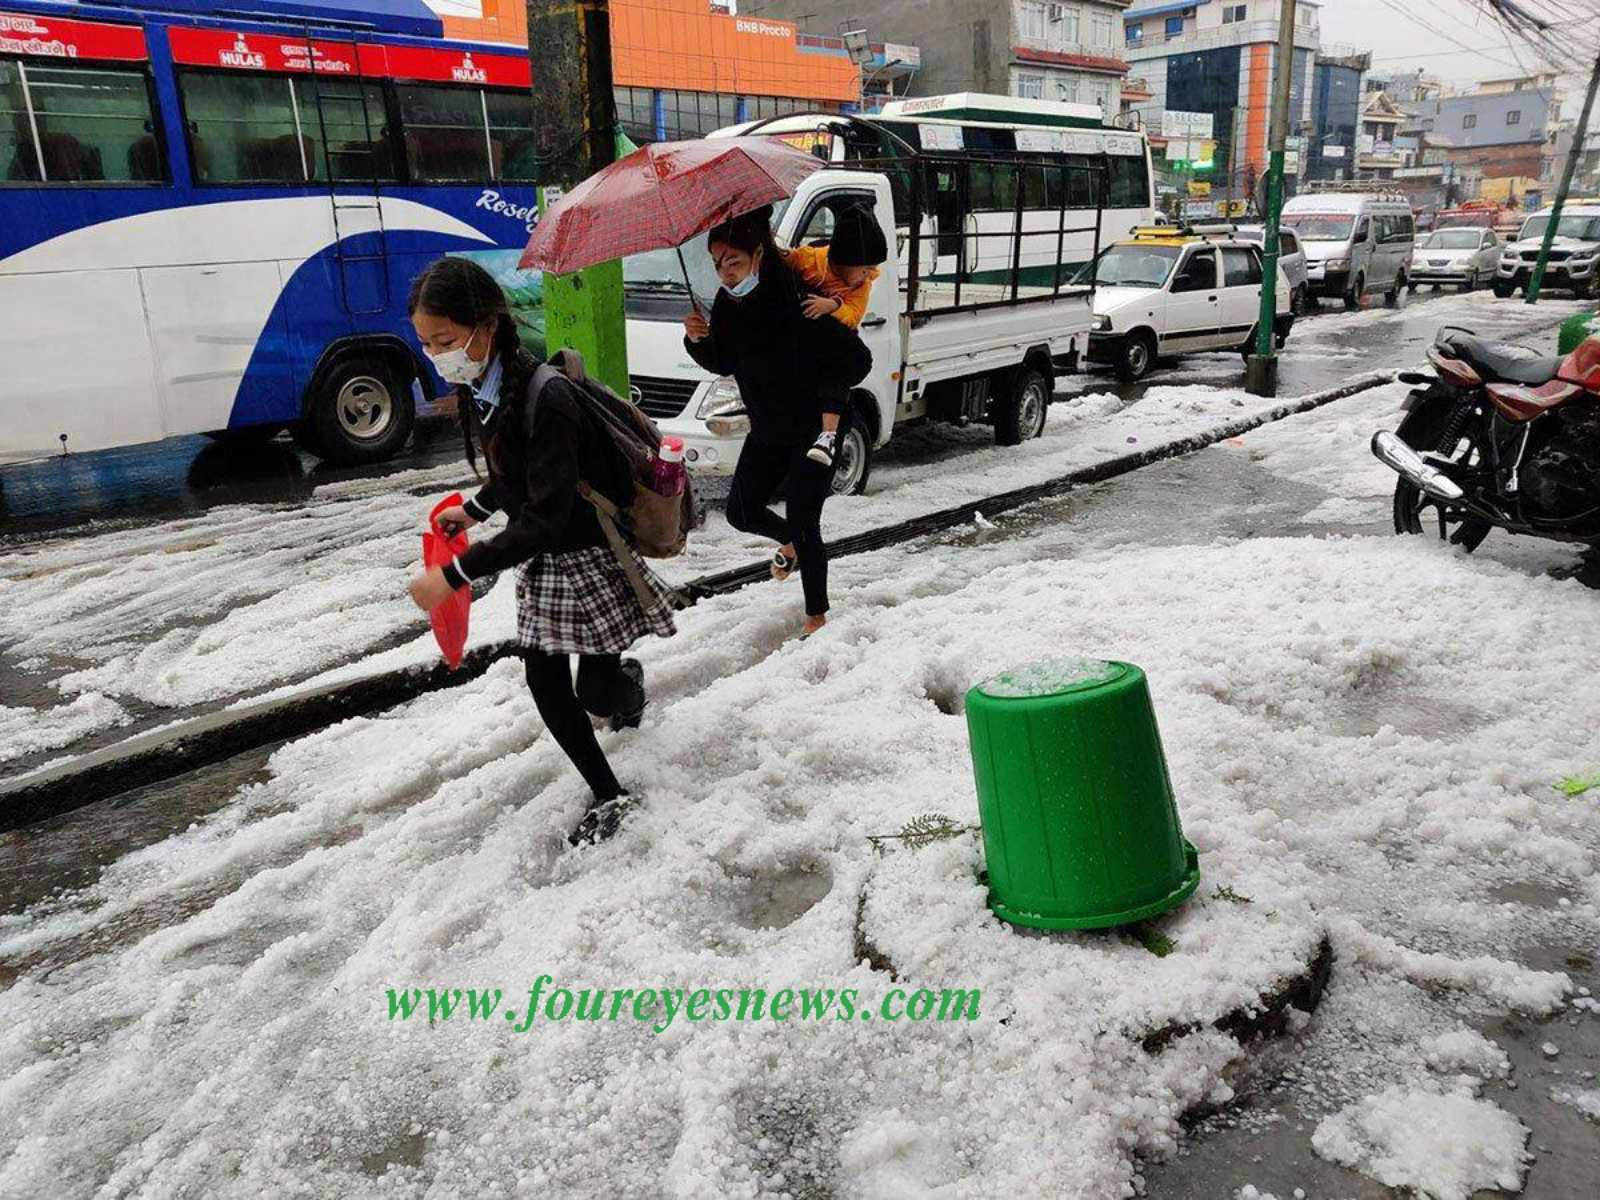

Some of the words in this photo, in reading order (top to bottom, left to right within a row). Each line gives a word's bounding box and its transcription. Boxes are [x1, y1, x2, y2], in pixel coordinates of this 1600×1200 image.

[736, 19, 758, 34] BNB
[220, 50, 264, 67] HULAS
[452, 67, 488, 81] HULAS
